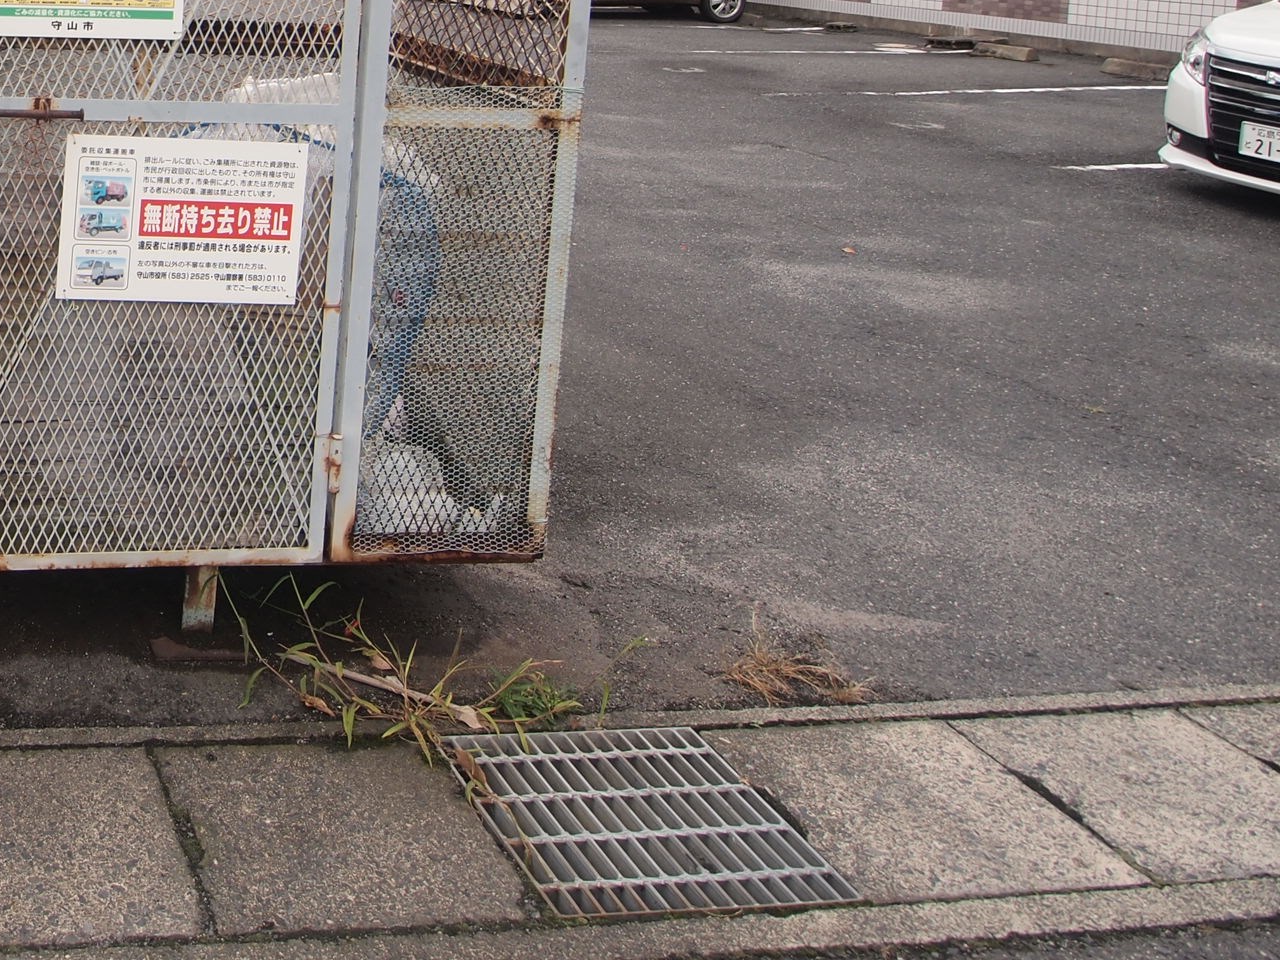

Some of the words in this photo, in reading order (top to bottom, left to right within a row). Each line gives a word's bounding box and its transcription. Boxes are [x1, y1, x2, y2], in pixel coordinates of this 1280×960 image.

[51, 21, 95, 31] 守山市
[143, 202, 289, 237] 無断持ち去り禁止
